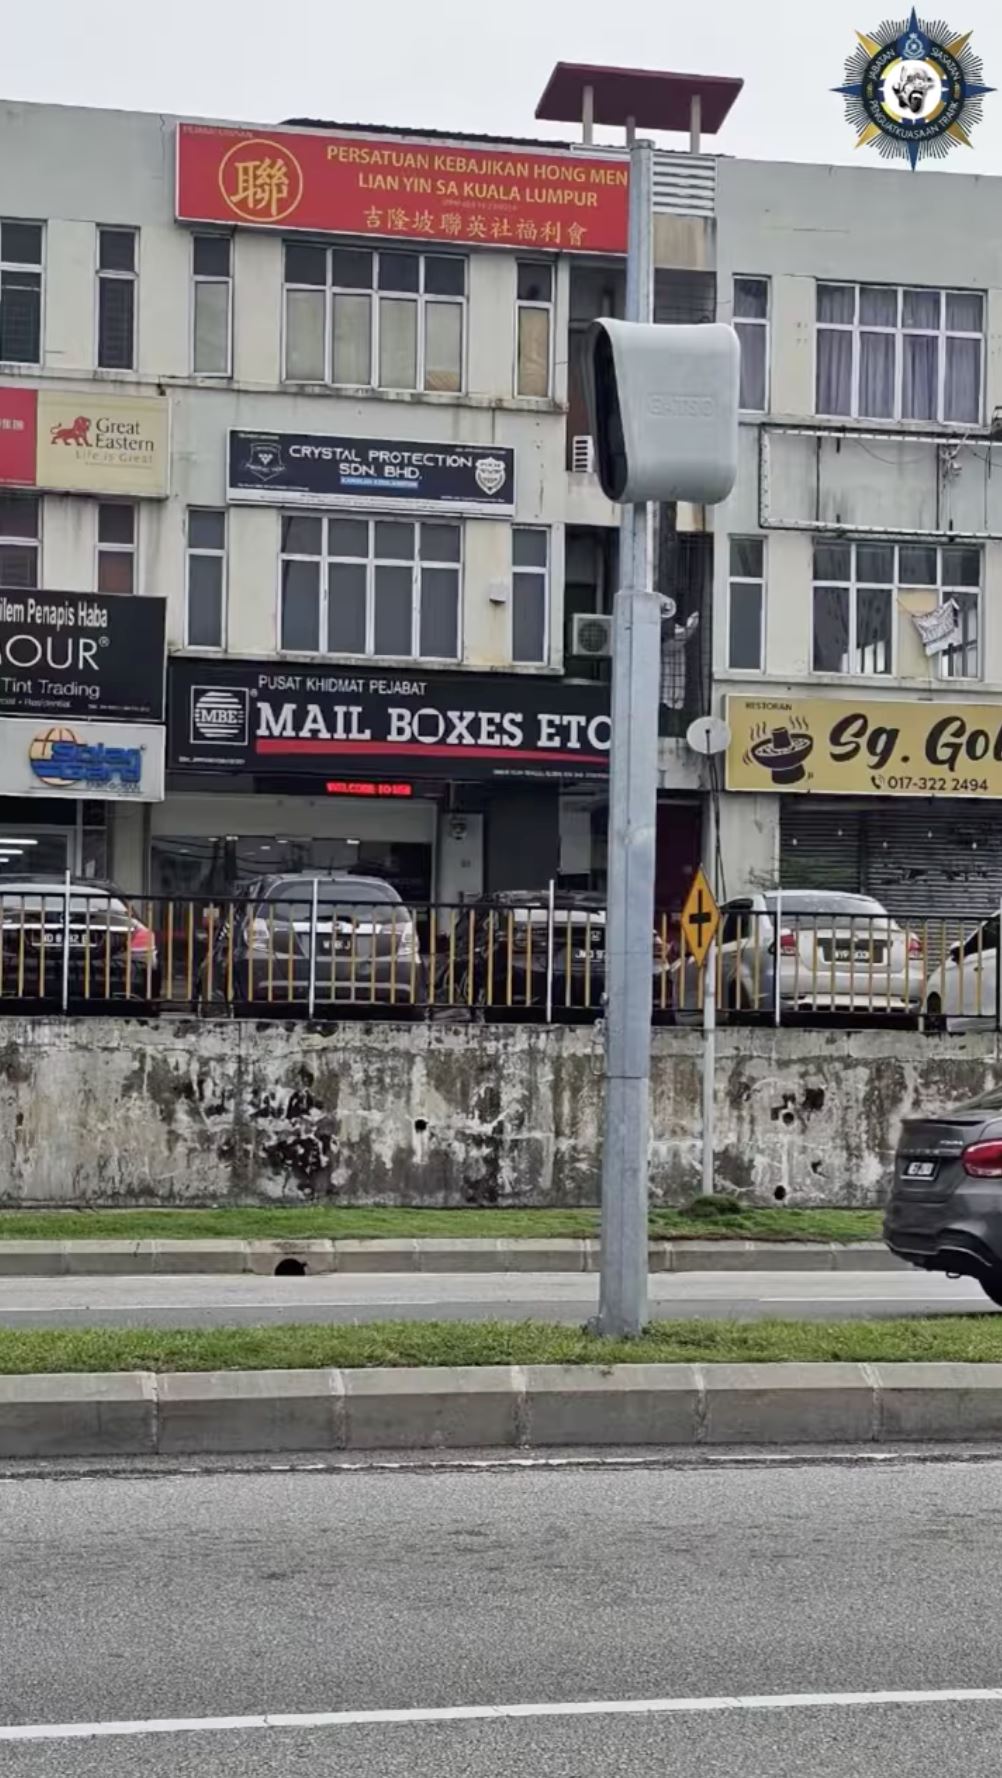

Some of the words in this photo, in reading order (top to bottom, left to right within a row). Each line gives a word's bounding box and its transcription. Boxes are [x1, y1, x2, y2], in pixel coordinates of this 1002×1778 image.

[327, 144, 429, 170] PERSATUAN
[434, 155, 529, 177] KEBAJIKAN
[534, 164, 585, 182] HONG
[590, 169, 628, 187] MEN
[230, 156, 289, 217] 聯
[359, 173, 399, 191] LIAN
[404, 176, 431, 194] YIN
[436, 180, 459, 197] SA
[463, 182, 521, 202] KUALA
[525, 187, 598, 207] LUMPUR
[363, 205, 588, 246] 吉隆坡聯英社福利會
[96, 417, 140, 436] Great
[96, 434, 155, 452] Eastern
[75, 450, 98, 460] Life
[104, 451, 114, 462] is
[119, 452, 153, 464] Great
[288, 444, 361, 462] CRYSTAL
[367, 450, 473, 468] PROTECTION
[339, 463, 377, 477] SDN.
[384, 465, 422, 480] BHD.
[27, 598, 75, 632] Penapis
[78, 601, 108, 628] Haba
[1, 677, 32, 694] Tint
[38, 679, 100, 700] Trading
[258, 674, 302, 691] PUSAT
[306, 678, 364, 693] KHIDMAT
[369, 679, 427, 696] PEJABAT
[201, 709, 238, 724] MBE
[745, 701, 793, 711] RESTORAN
[256, 701, 372, 740] MAIL
[386, 707, 523, 747] BOXES
[829, 713, 910, 770] Sg.
[887, 776, 947, 791] 017-322
[951, 778, 989, 792] 2494
